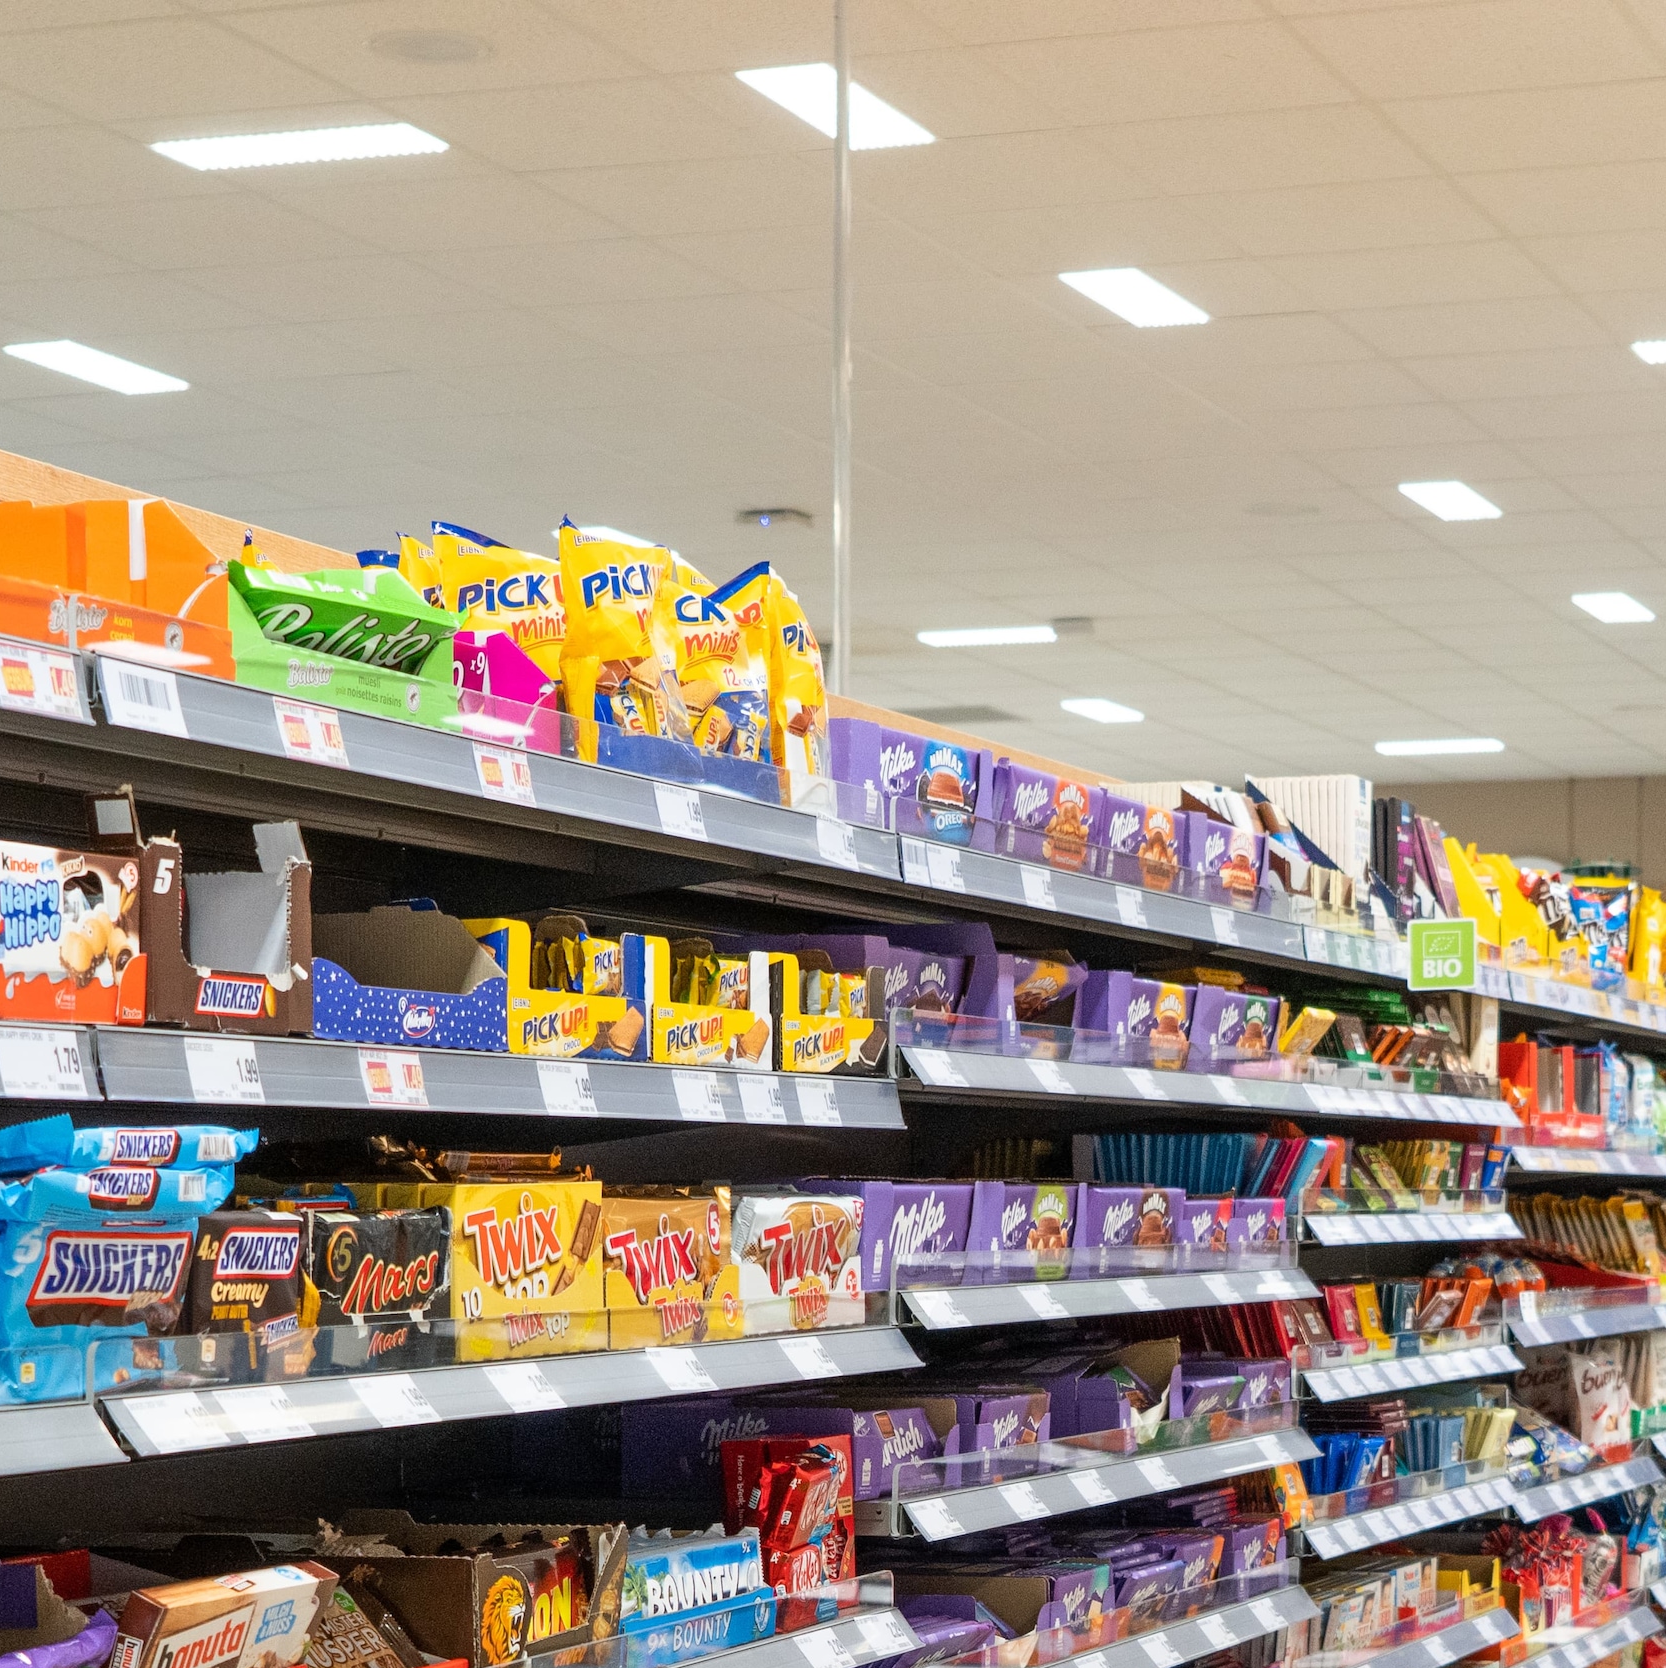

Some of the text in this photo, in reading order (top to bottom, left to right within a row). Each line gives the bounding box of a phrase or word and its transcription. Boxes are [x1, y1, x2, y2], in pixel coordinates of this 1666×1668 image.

[288, 660, 334, 687] Balisto
[347, 687, 402, 708] noisettes raisins
[880, 742, 962, 829] Milka OREO
[1014, 782, 1049, 819] Milka
[1109, 811, 1140, 841] Milka
[154, 858, 175, 896] 5
[0, 879, 60, 926] Happy
[6, 908, 61, 952] Hippo
[1422, 959, 1461, 979] BIO
[199, 979, 263, 1015] SNICKERS
[54, 1048, 81, 1075] 1.79
[235, 1058, 261, 1083] 1.99
[575, 1079, 592, 1100] 1.99
[115, 1132, 174, 1162] SNICKERS
[891, 1198, 955, 1256] Milka
[1002, 1202, 1027, 1241] Milka
[1104, 1199, 1137, 1241] Milka
[217, 1233, 299, 1275] SNICKERS
[464, 1194, 563, 1286] Twix
[607, 1208, 697, 1303] Twix
[761, 1209, 847, 1294] Twix
[49, 1241, 185, 1297] SNICKERS
[347, 1249, 439, 1309] Mars
[211, 1281, 269, 1308] Creamy
[461, 1289, 482, 1322] 10
[504, 1310, 569, 1348] Twix top
[324, 1612, 368, 1634] MISTER
[647, 1621, 732, 1652] 9x BOUNTY
